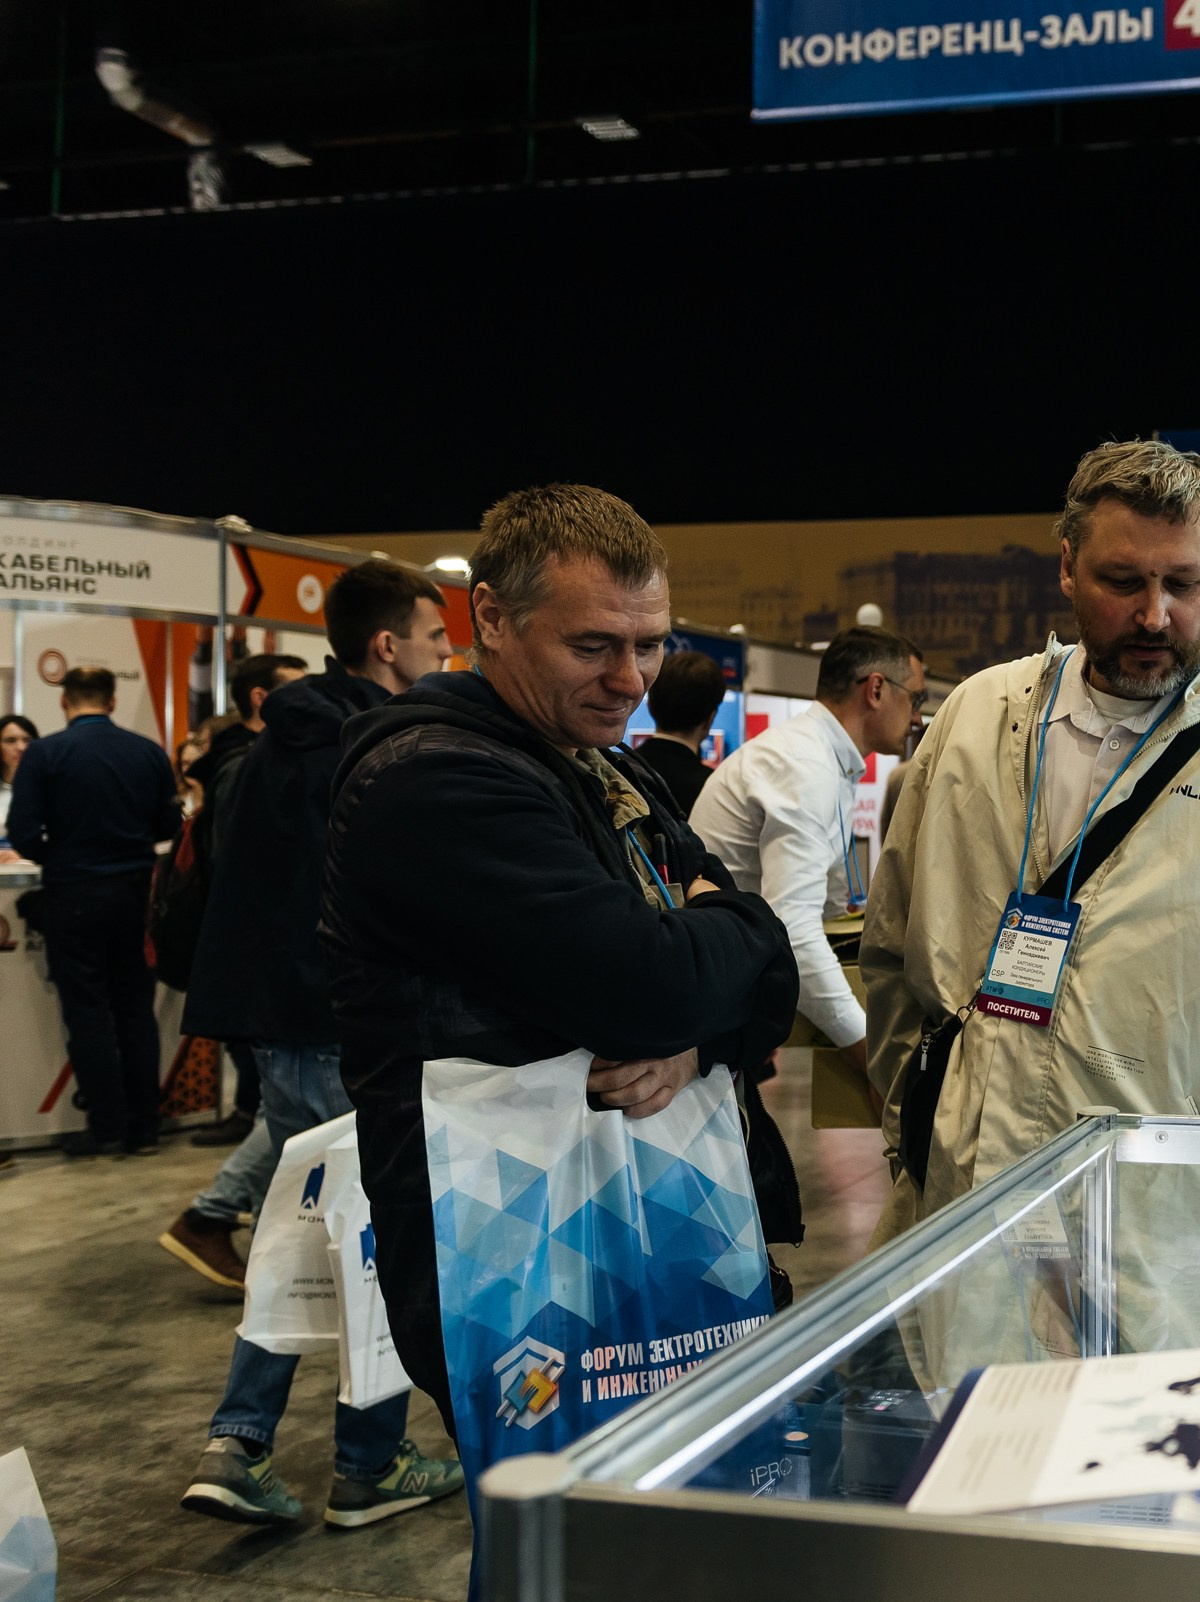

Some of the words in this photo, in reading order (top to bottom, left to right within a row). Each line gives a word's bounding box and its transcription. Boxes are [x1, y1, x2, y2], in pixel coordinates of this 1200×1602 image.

[779, 7, 1154, 69] КОНФЕРЕНЦ-ЗАЛЫ
[991, 968, 1006, 977] CSP
[986, 1001, 1041, 1021] ПОСЕТИТЕЛЬ
[580, 1342, 644, 1373] ФОРУМ
[581, 1379, 592, 1404] И
[750, 1457, 793, 1487] iPRO
